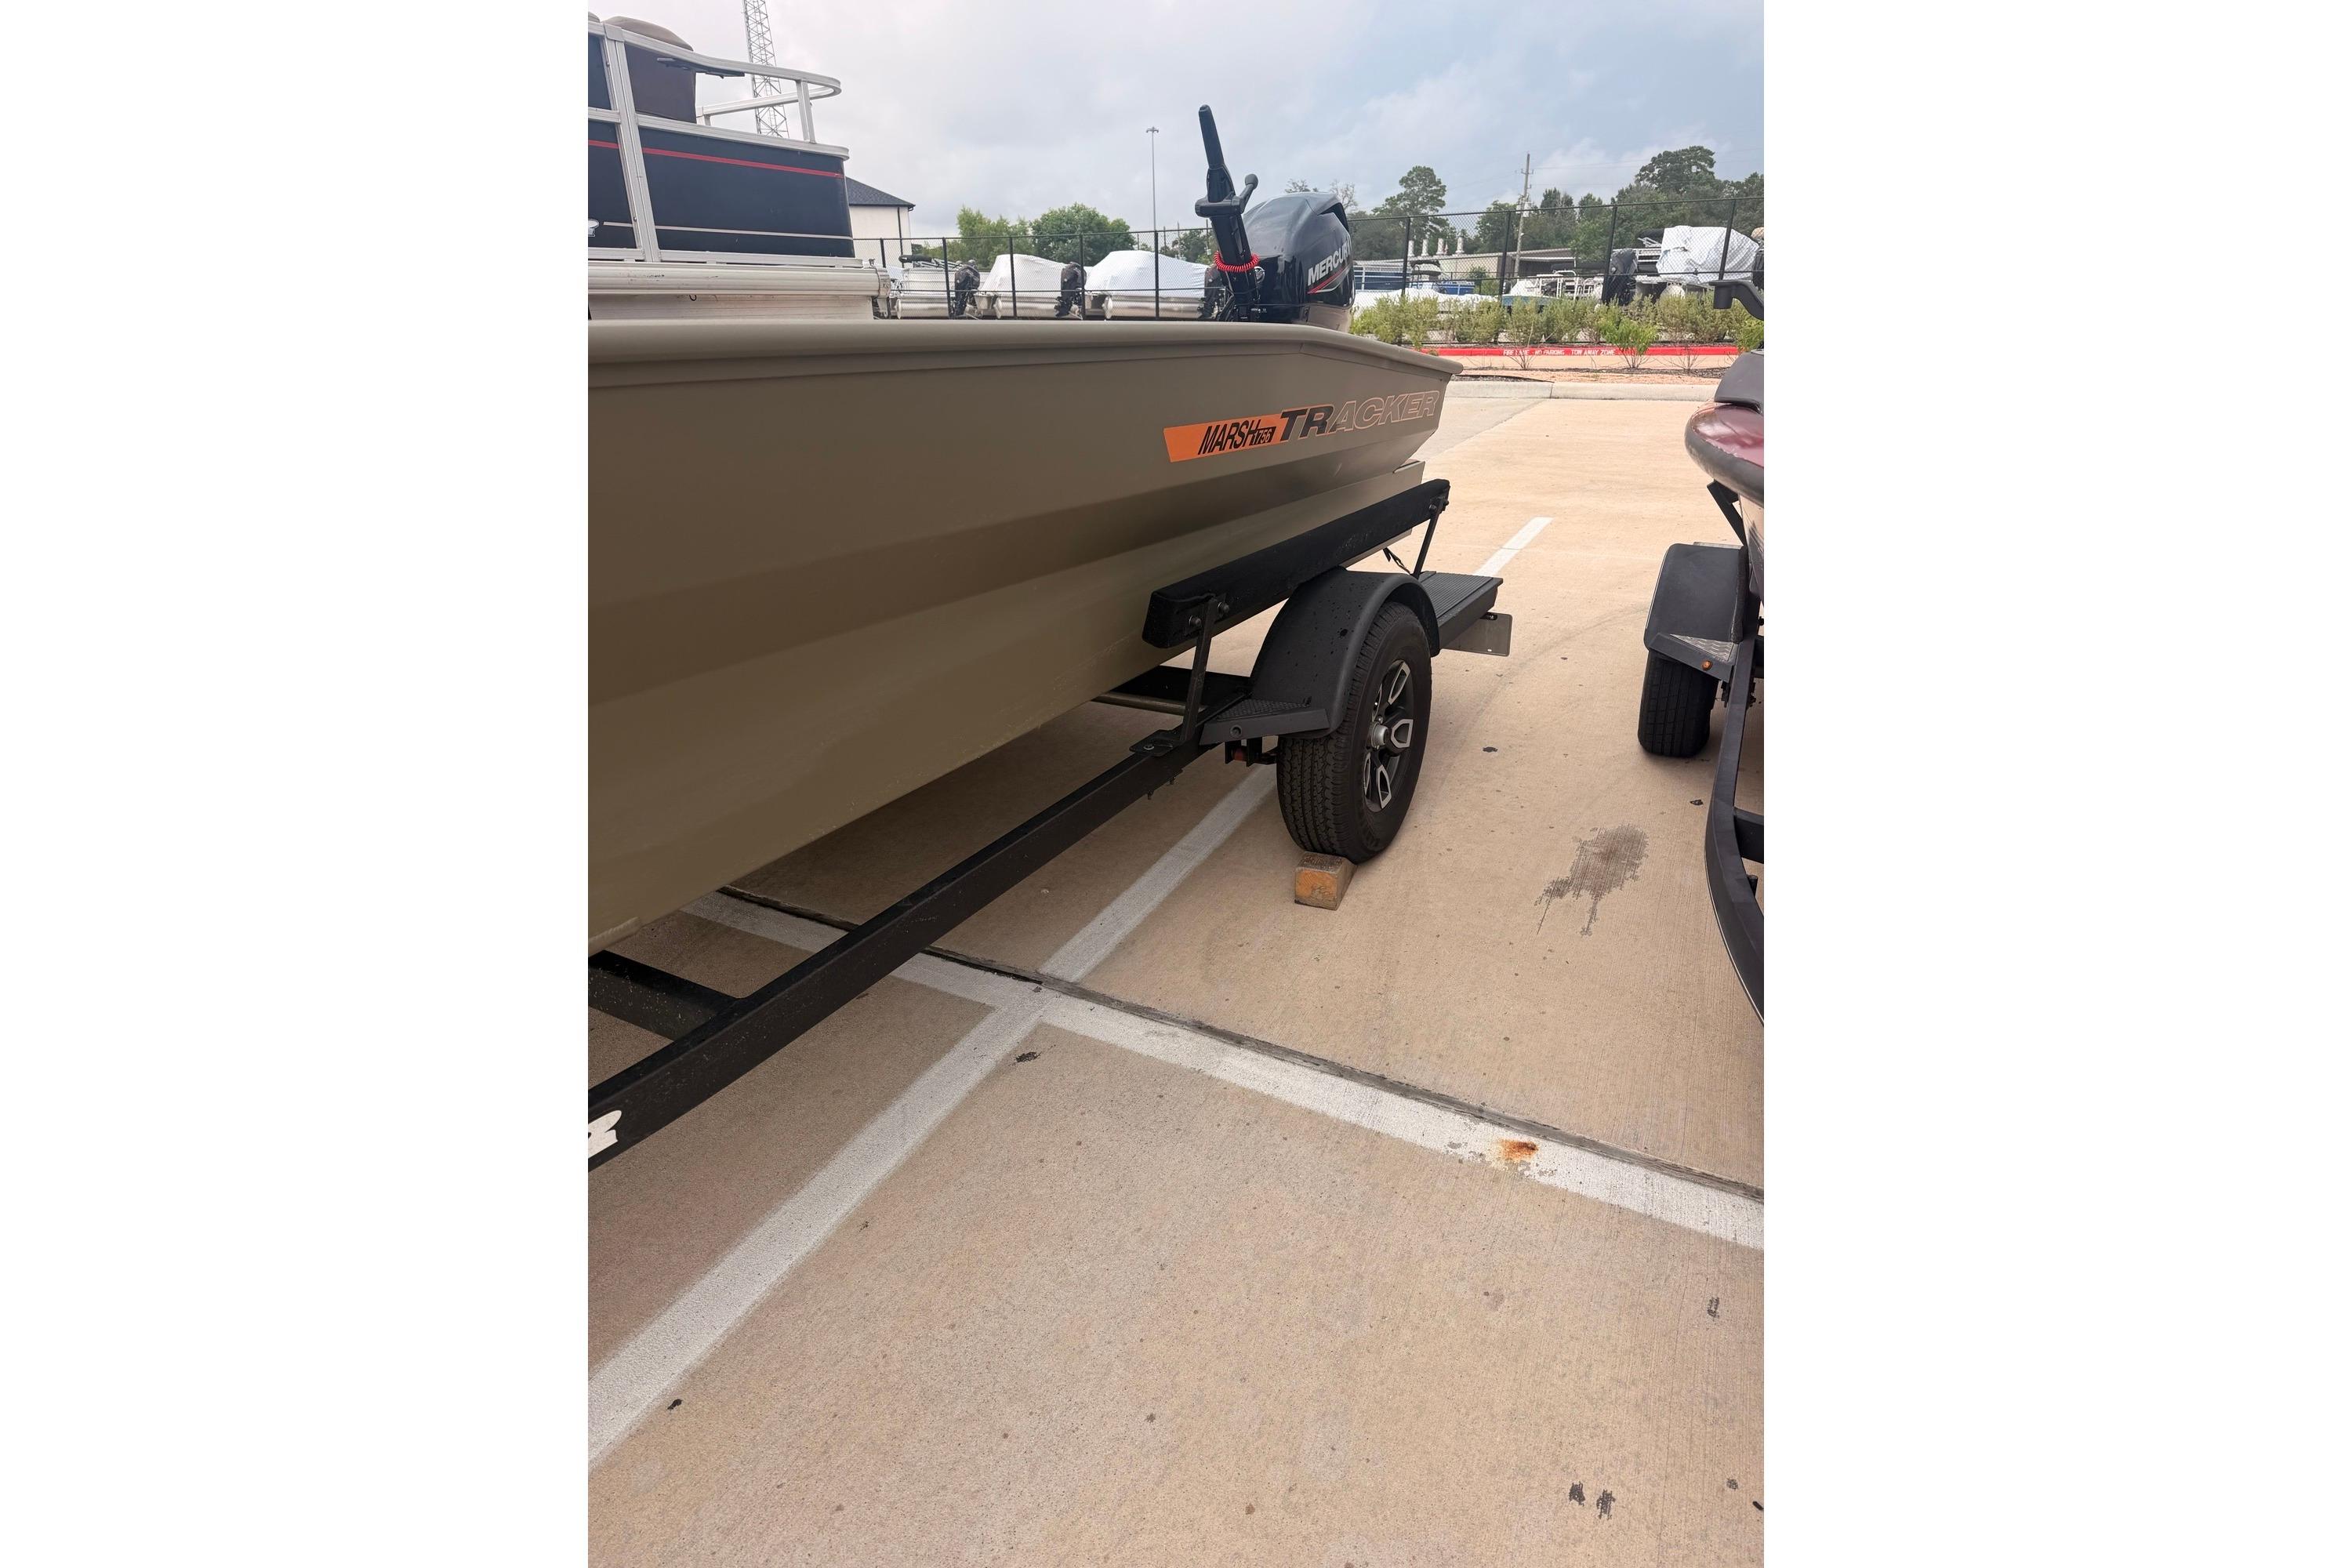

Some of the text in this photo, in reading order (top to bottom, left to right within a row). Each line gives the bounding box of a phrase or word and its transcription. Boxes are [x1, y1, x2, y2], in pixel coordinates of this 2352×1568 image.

[1198, 390, 1439, 455] MARSH 1756 TRACKER
